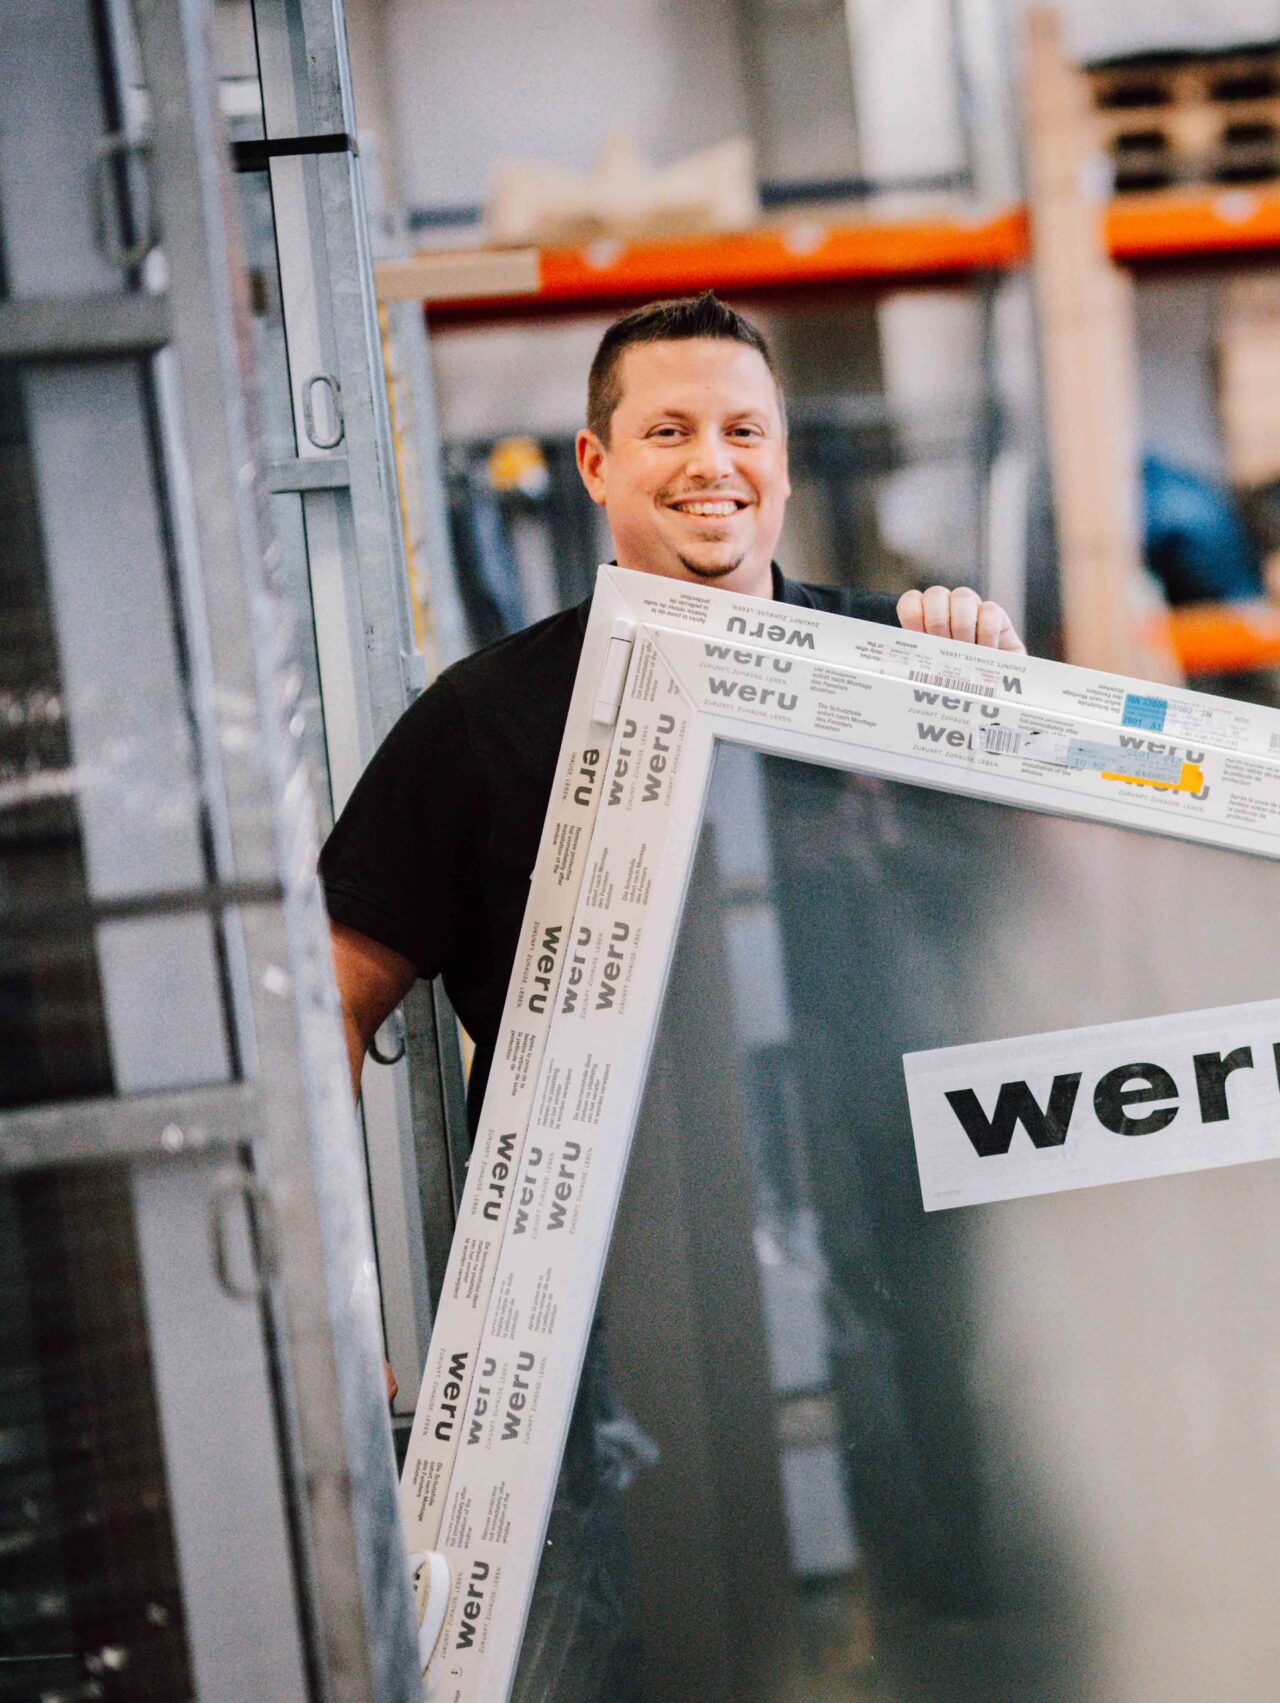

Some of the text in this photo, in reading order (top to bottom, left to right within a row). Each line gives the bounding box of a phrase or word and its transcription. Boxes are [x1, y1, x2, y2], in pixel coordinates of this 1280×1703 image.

[726, 616, 814, 649] weru
[708, 677, 797, 710] weru
[573, 748, 599, 806] eru
[641, 713, 675, 802] weru
[528, 925, 562, 1013] weru
[595, 921, 629, 1009] weru
[483, 1132, 516, 1220] weru
[546, 1140, 580, 1230] weru
[434, 1352, 468, 1441] weru
[500, 1351, 534, 1440] weru
[455, 1560, 489, 1649] weru
